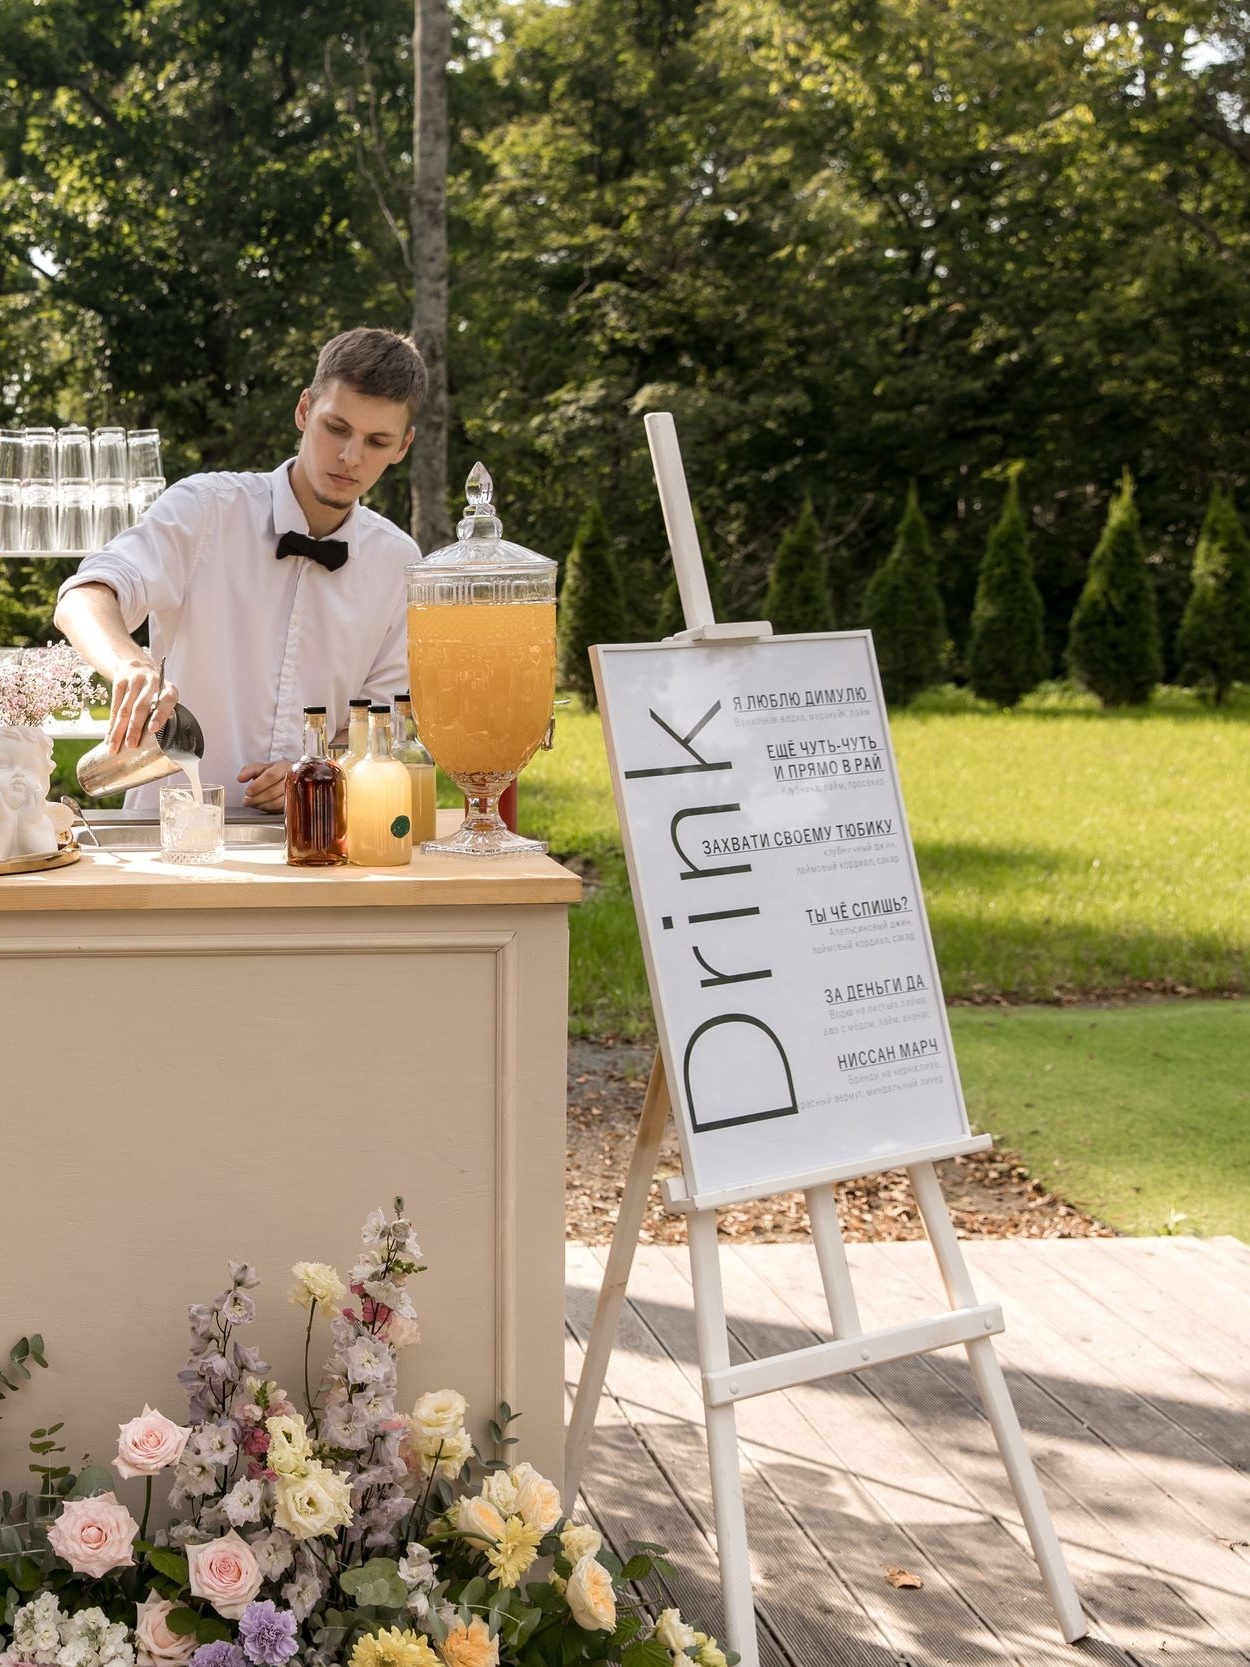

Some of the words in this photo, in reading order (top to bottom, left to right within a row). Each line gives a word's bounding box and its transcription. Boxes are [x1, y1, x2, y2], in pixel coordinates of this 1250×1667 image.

[733, 696, 742, 711] Я
[747, 692, 801, 710] ЛЮБЛЮ
[805, 686, 867, 707] ДИМУЛЮ
[766, 739, 797, 760] ЕЩЁ
[800, 735, 877, 756] ЧУТЬ-ЧУТЬ
[774, 765, 785, 780] И
[788, 760, 838, 779] ПРЯМО
[842, 759, 852, 773] В
[855, 753, 883, 771] РАЙ
[702, 832, 770, 855] ЗАХВАТИ
[774, 825, 832, 847] СВОЕМУ
[835, 818, 893, 839] ТЮБИКУ
[625, 699, 799, 1134] Drink
[805, 908, 827, 924] ТЫ
[830, 901, 849, 920] ЧЁ
[852, 896, 908, 917] СПИШЬ?
[824, 988, 843, 1004] ЗА
[847, 977, 902, 1002] ДЕНЬГИ
[906, 974, 925, 993] ДА
[837, 1045, 897, 1070] НИССАН
[899, 1037, 939, 1059] МАРЧ
